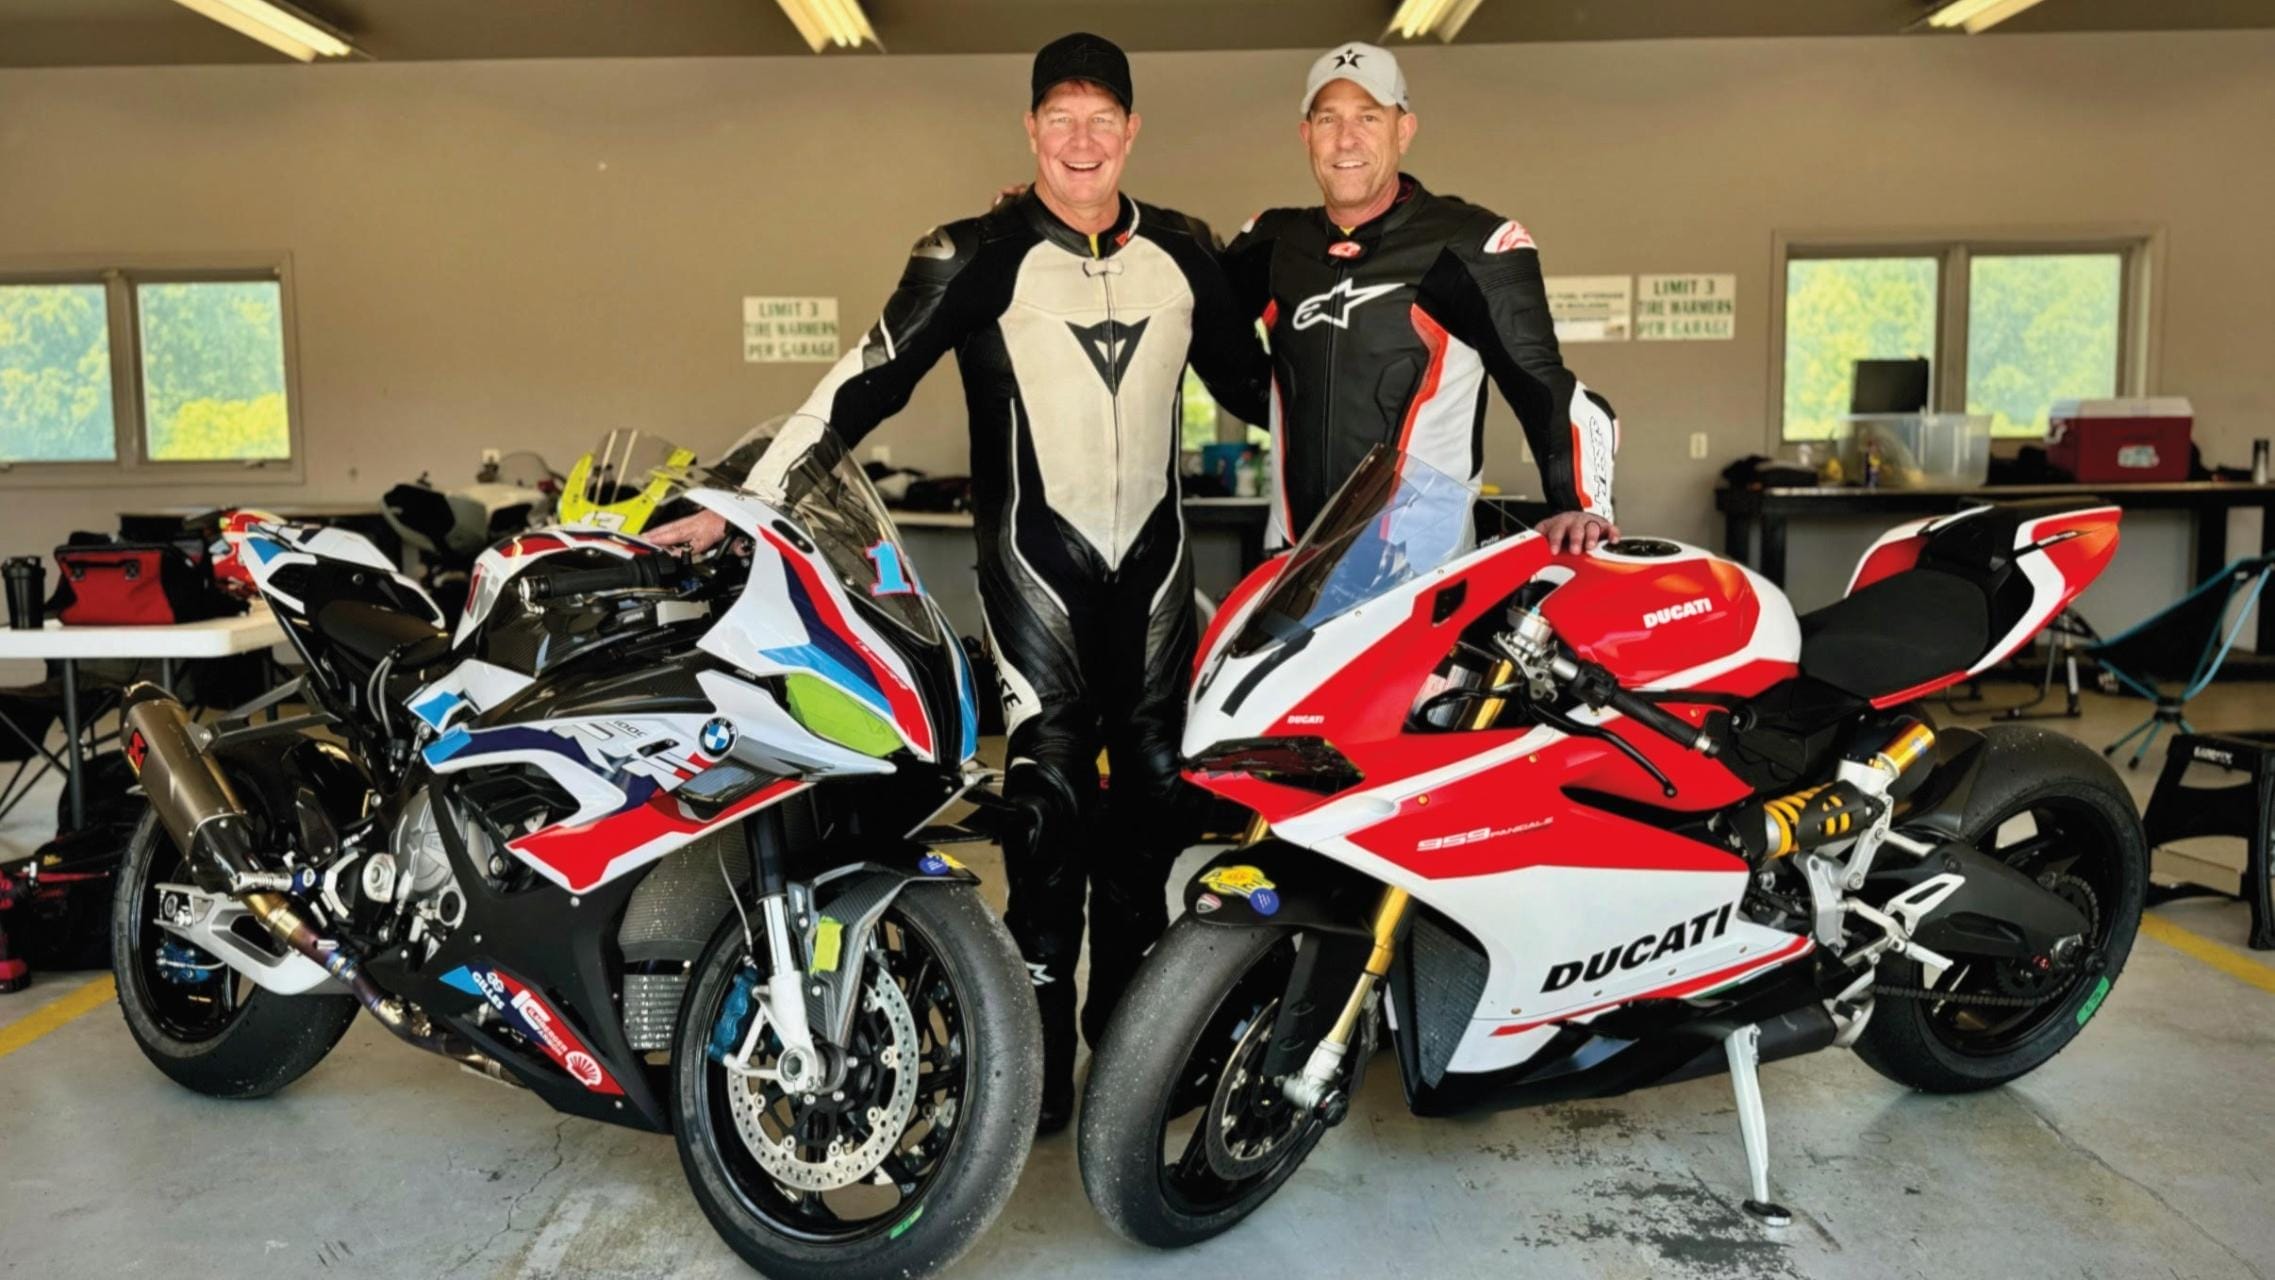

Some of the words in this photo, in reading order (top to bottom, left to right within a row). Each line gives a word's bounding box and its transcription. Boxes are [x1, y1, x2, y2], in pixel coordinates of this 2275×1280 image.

[1653, 280, 1697, 296] LIMIT
[1704, 279, 1715, 295] 3
[758, 302, 801, 318] LIMIT
[1636, 322, 1664, 337] PER
[1671, 321, 1729, 337] GARAGE
[780, 342, 835, 358] GARAGE
[1642, 597, 1713, 629] DUCATI
[1287, 715, 1325, 724] DUCATI
[1416, 827, 1491, 852] 959
[1539, 901, 1733, 994] DUCATI
[471, 971, 506, 1011] GILLES
